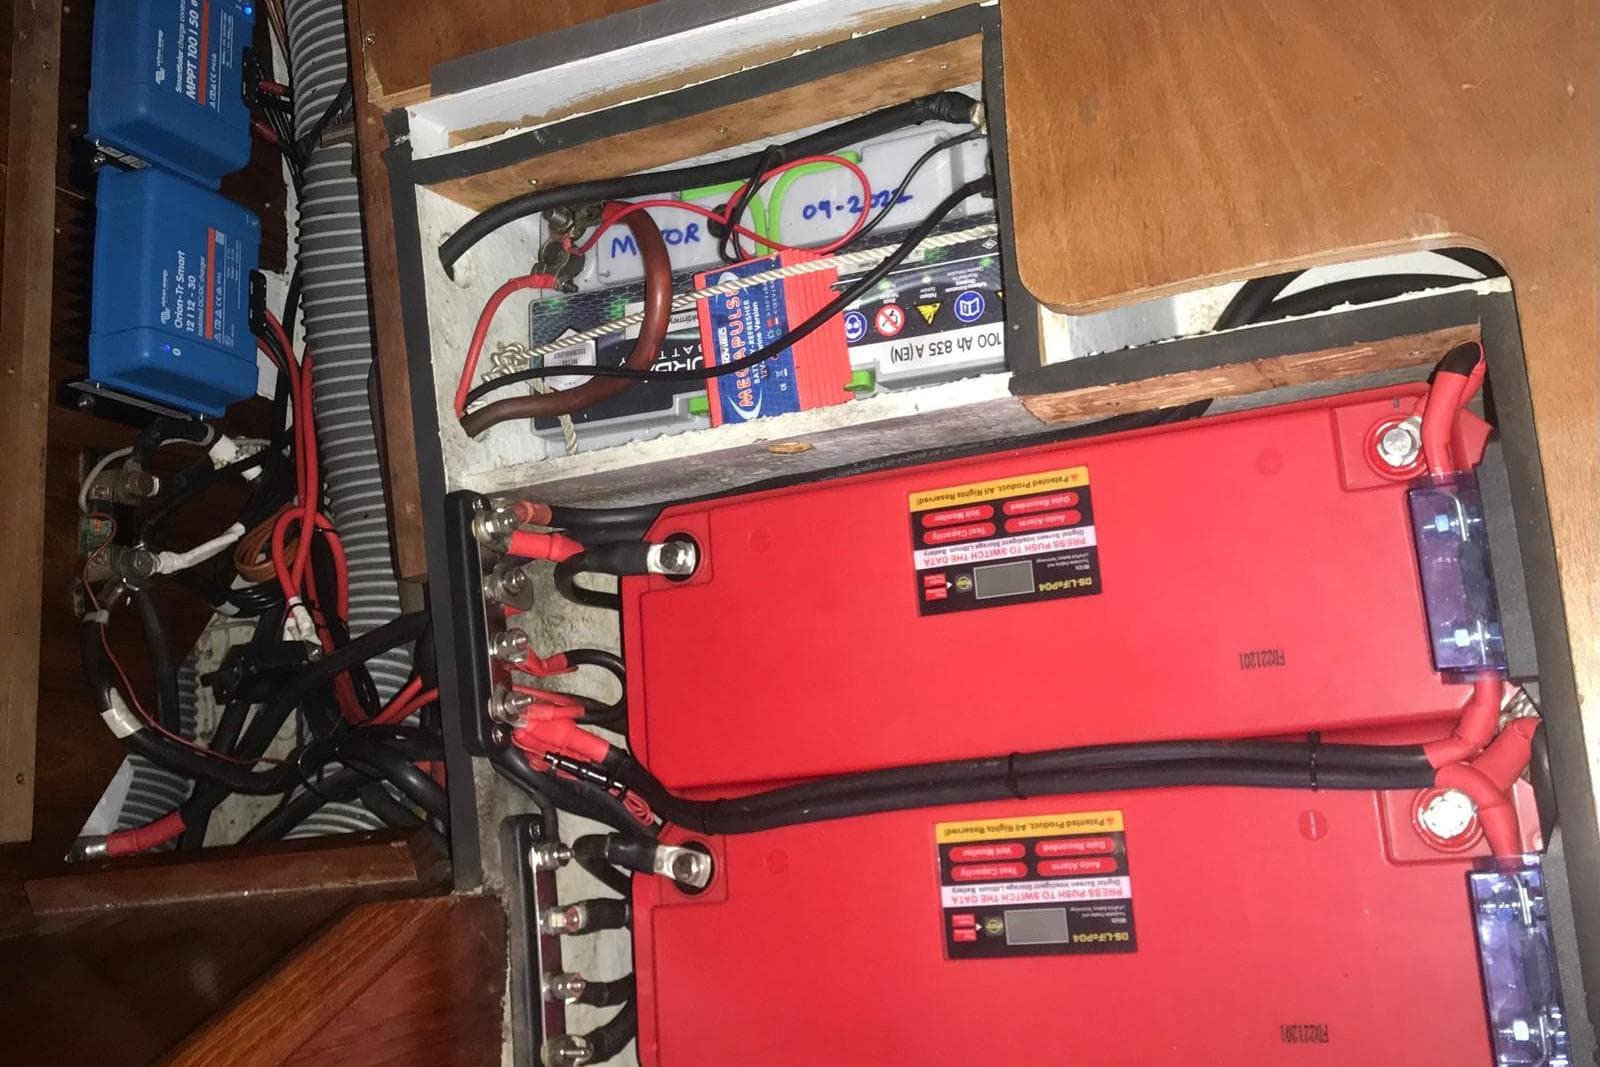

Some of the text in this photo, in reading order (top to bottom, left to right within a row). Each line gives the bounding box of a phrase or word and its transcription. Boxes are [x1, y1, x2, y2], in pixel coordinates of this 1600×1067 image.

[189, 10, 198, 27] 50
[188, 37, 198, 59] 100
[186, 60, 197, 99] MPPT
[611, 223, 700, 258] MOR
[188, 275, 196, 290] 30
[174, 250, 185, 328] Orion-Tr Smart
[187, 300, 195, 311] 12
[753, 301, 762, 330] Version
[187, 321, 194, 332] 12
[957, 336, 973, 352] Ah
[978, 332, 1002, 348] 100
[929, 340, 953, 356] 835
[1033, 476, 1069, 488] Patented
[957, 487, 983, 498] Rights
[984, 487, 995, 496] All
[916, 493, 955, 505] Reserved!
[1010, 499, 1049, 511] Recorded
[934, 509, 981, 522] Volt Monitor
[1018, 514, 1066, 528] Auto Alarm
[931, 529, 966, 541] Capacity
[924, 529, 1084, 556] Digital Screen Intelligent Storage Lithium Battery
[923, 537, 1086, 566] PRESS PUSH TO SWITCH THE DATA
[987, 824, 1014, 834] Rights
[1016, 824, 1027, 833] All
[1067, 818, 1105, 829] Patented
[944, 826, 985, 837] Reserved!
[962, 847, 1011, 858] Volt Monitor
[1042, 842, 1084, 853] Recorded
[960, 867, 997, 878] Capacity
[1051, 861, 1101, 873] Auto Alarm
[952, 879, 1120, 894] Digital Screen Intelligent Storage Lithium Battery
[951, 887, 1123, 905] PRESS PUSH TO SWITCH THE DATA
